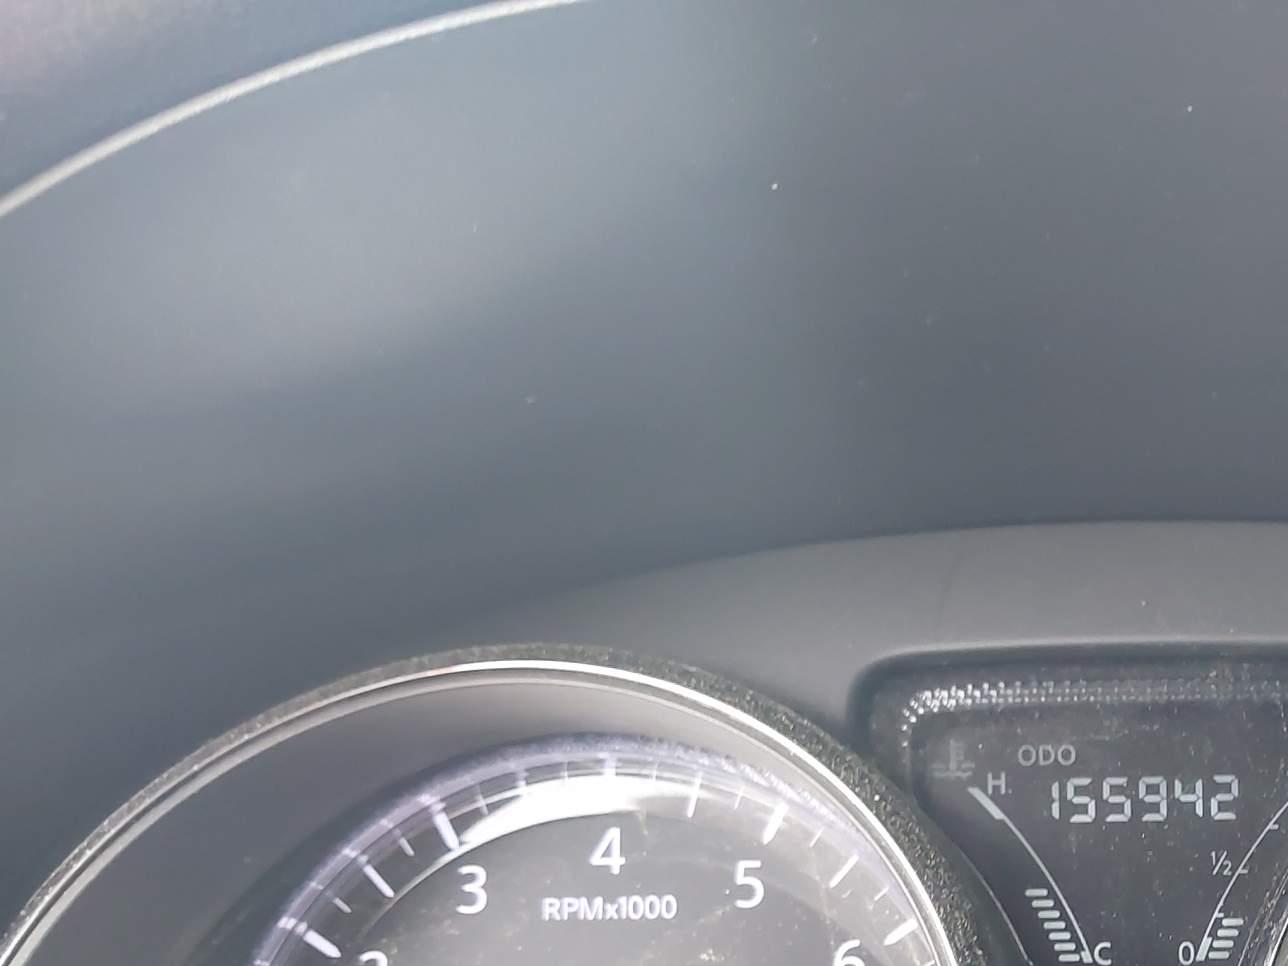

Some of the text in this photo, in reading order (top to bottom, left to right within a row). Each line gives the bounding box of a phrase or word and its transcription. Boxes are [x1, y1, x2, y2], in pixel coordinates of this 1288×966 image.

[1018, 745, 1076, 766] ODO
[987, 774, 1005, 793] H
[1052, 775, 1239, 823] 155942
[590, 828, 625, 874] 4
[456, 867, 487, 914] 3
[735, 861, 764, 907] 5
[542, 895, 677, 920] RPMx1000
[1095, 943, 1112, 965] C
[1179, 943, 1194, 965] 0
